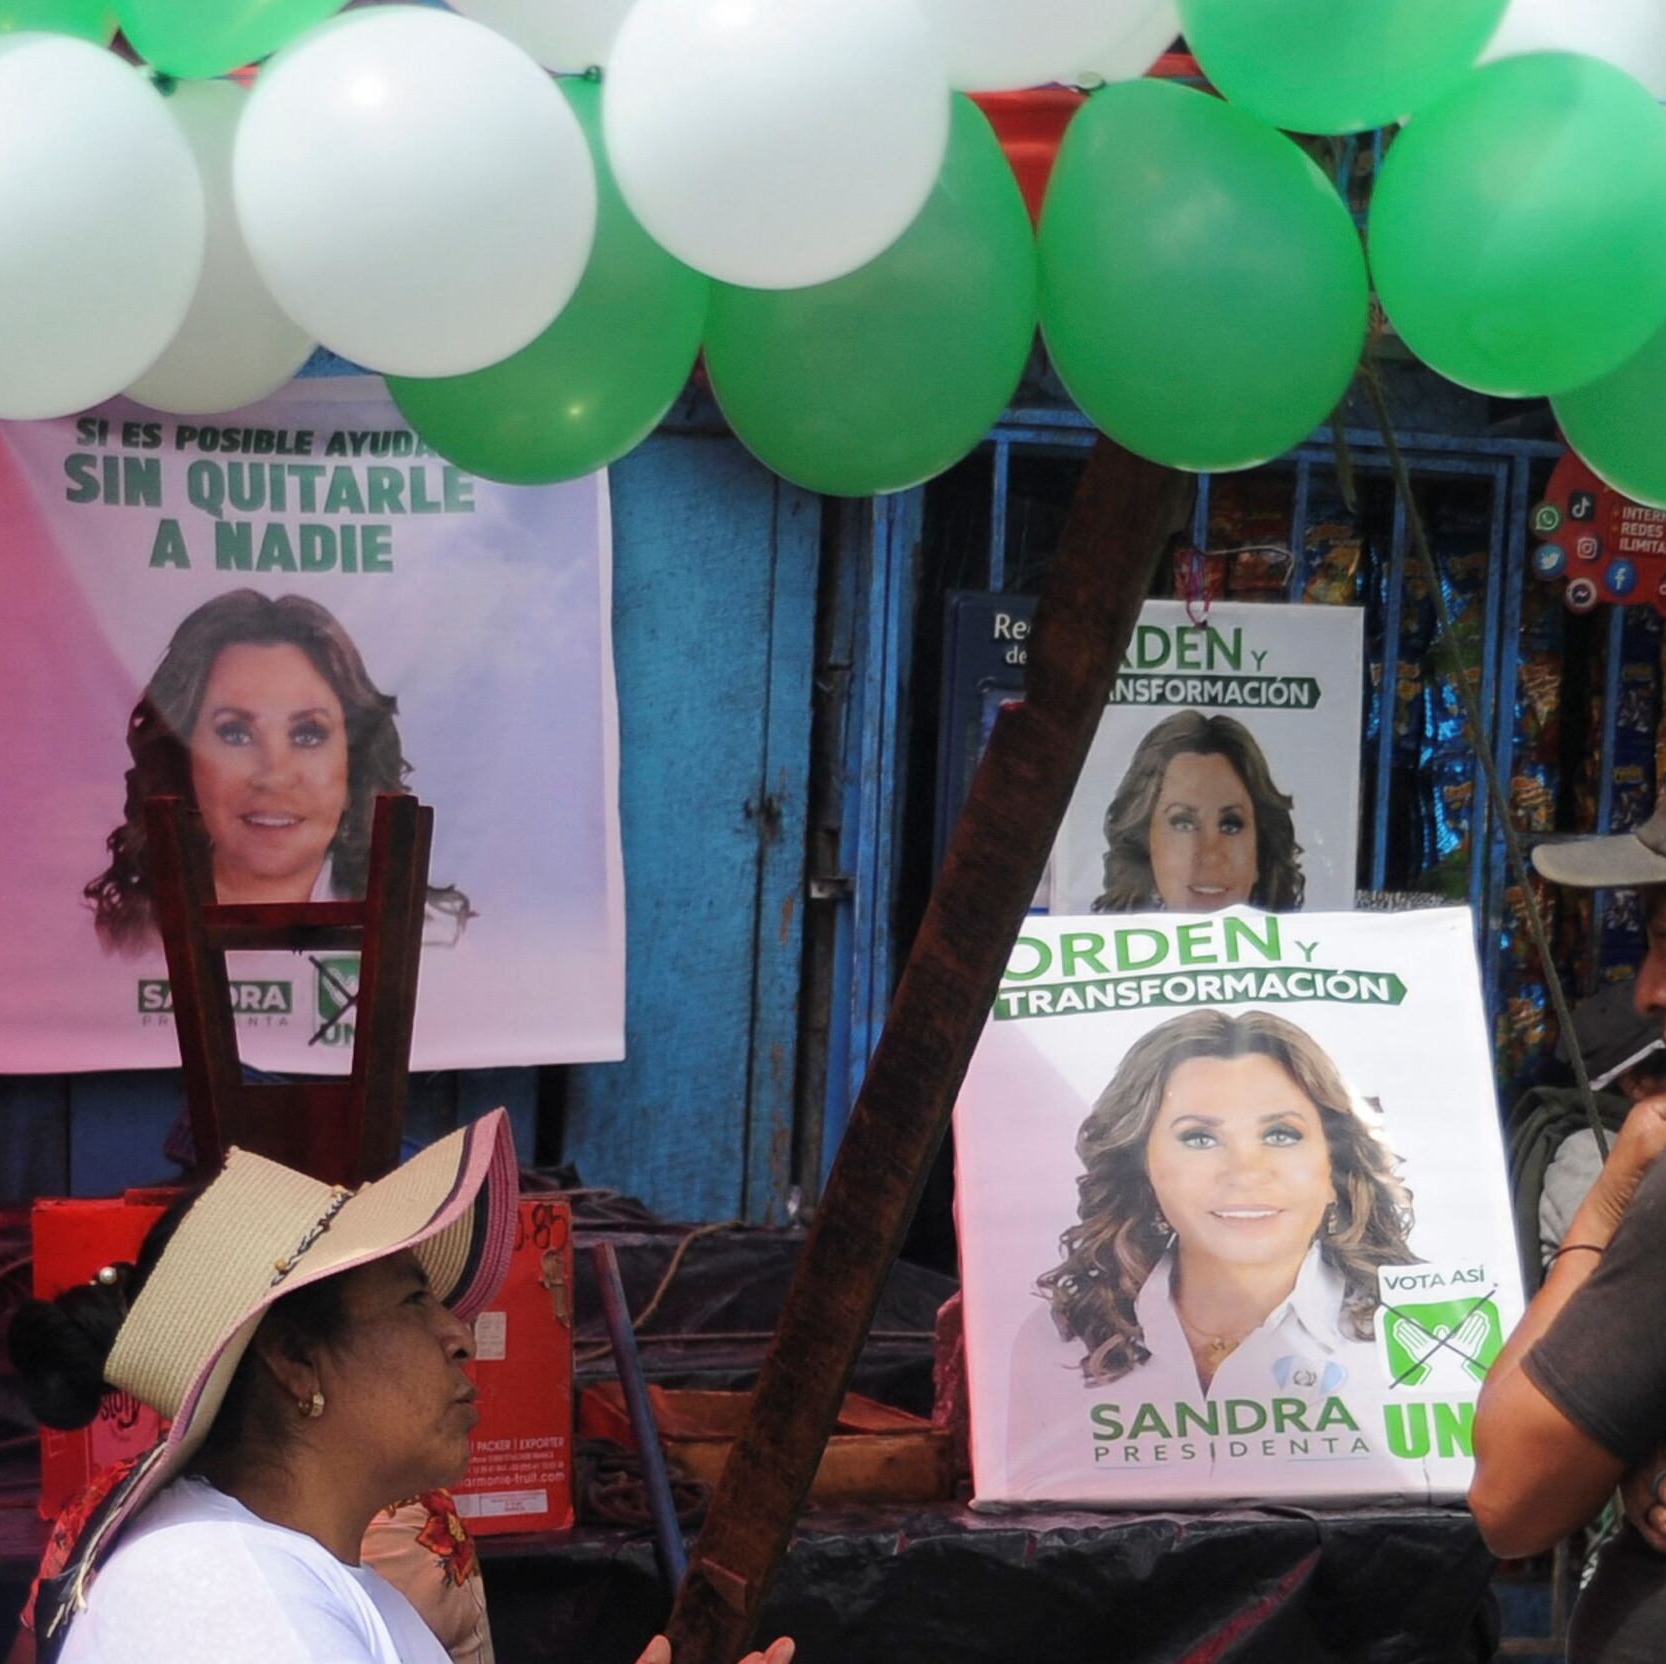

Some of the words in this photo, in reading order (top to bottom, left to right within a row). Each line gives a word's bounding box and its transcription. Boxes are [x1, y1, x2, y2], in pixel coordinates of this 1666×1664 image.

[76, 418, 109, 447] SI
[122, 422, 162, 450] ES
[176, 425, 313, 456] POSIBLE
[325, 430, 439, 458] AYUDA
[64, 453, 162, 507] SIN
[187, 459, 475, 520] QUITARLE
[149, 518, 191, 569] A
[214, 521, 393, 573] NADIE
[1621, 523, 1663, 538] REDES
[1121, 626, 1242, 670] DEN
[1251, 650, 1268, 671] Y
[1109, 676, 1310, 706] NSFORMACIÓN
[1004, 916, 1282, 981] ORDEN
[1295, 940, 1319, 962] Y
[1002, 969, 1391, 1017] TRANSFORMACIÓN
[1384, 1271, 1445, 1292] VOTA
[1451, 1264, 1486, 1285] ASÍ
[1090, 1396, 1361, 1442] SANDRA
[1094, 1436, 1371, 1462] PRESIDENTA
[1383, 1401, 1476, 1460] UN
